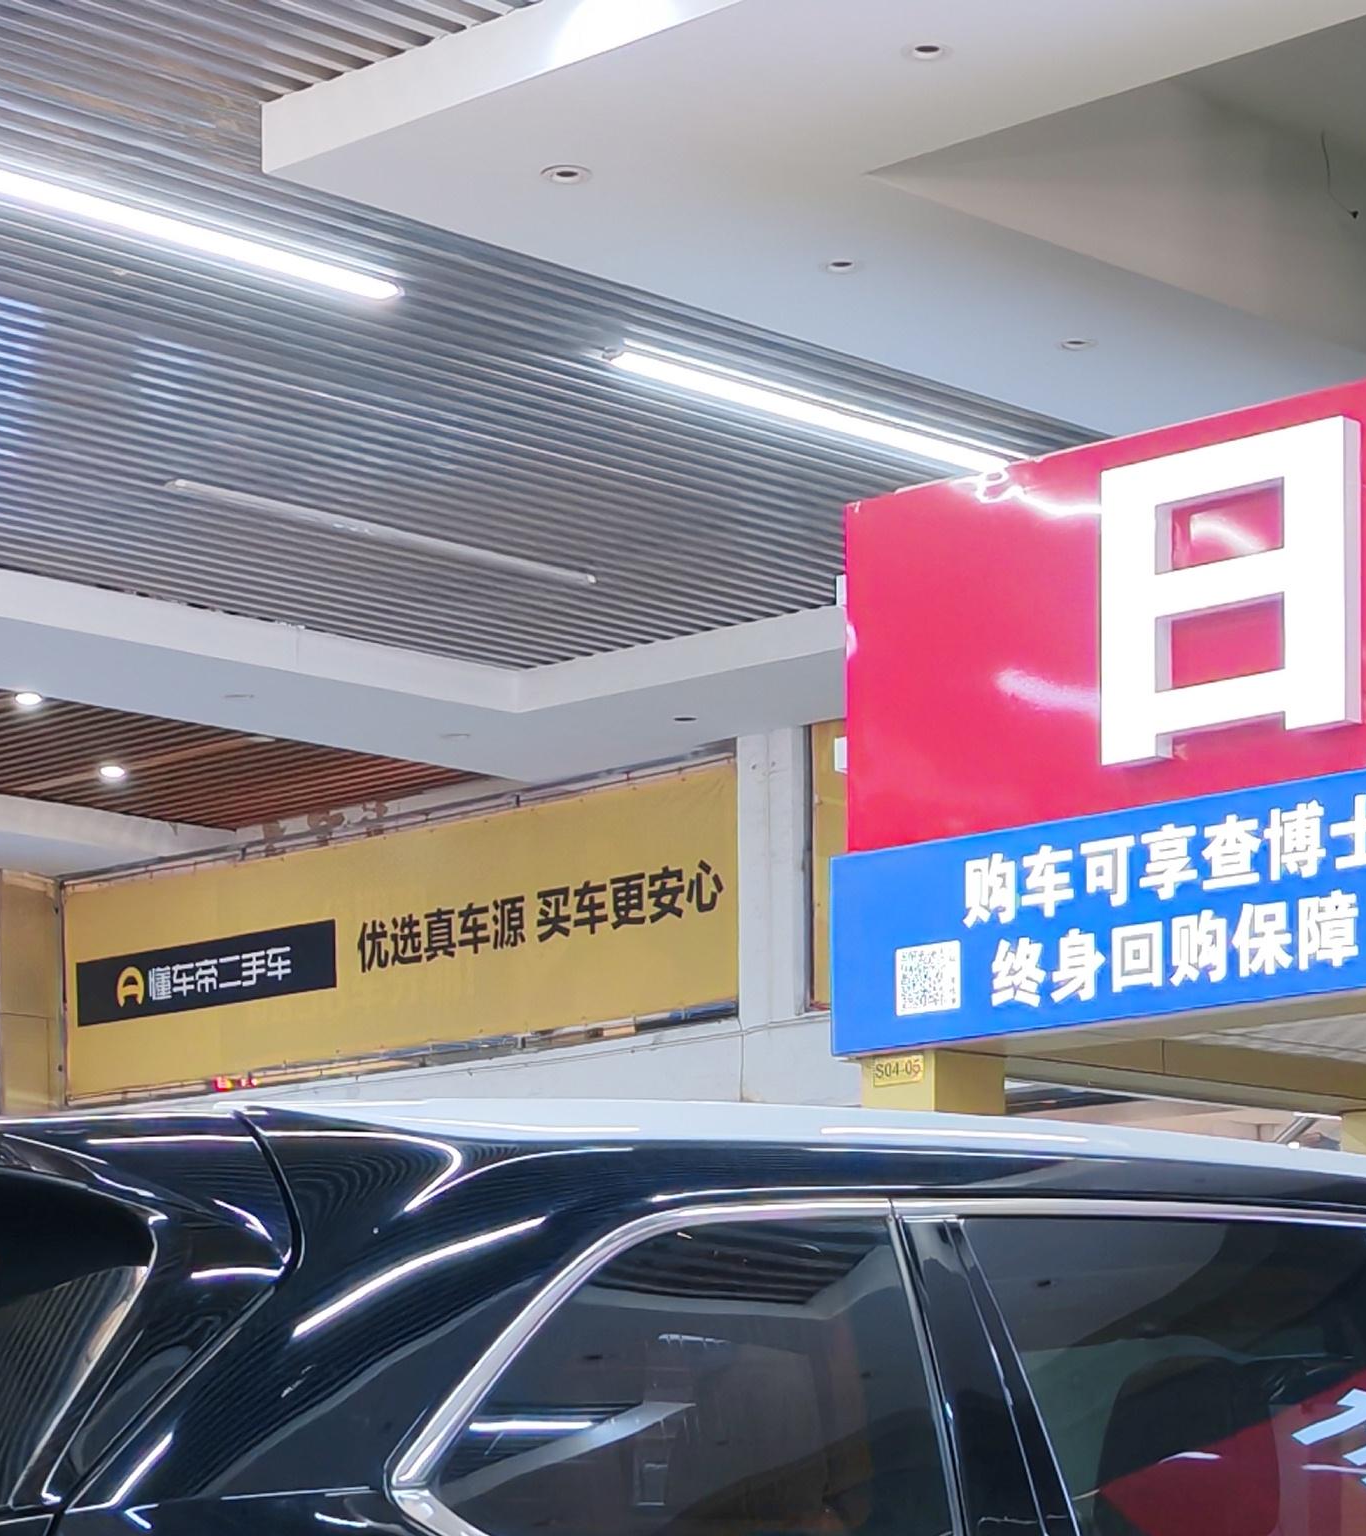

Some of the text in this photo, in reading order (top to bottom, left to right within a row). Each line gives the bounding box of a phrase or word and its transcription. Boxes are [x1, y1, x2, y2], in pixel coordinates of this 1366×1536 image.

[357, 858, 725, 974] 优选真车源 买车更安心
[990, 888, 1361, 1008] 终身回购保障
